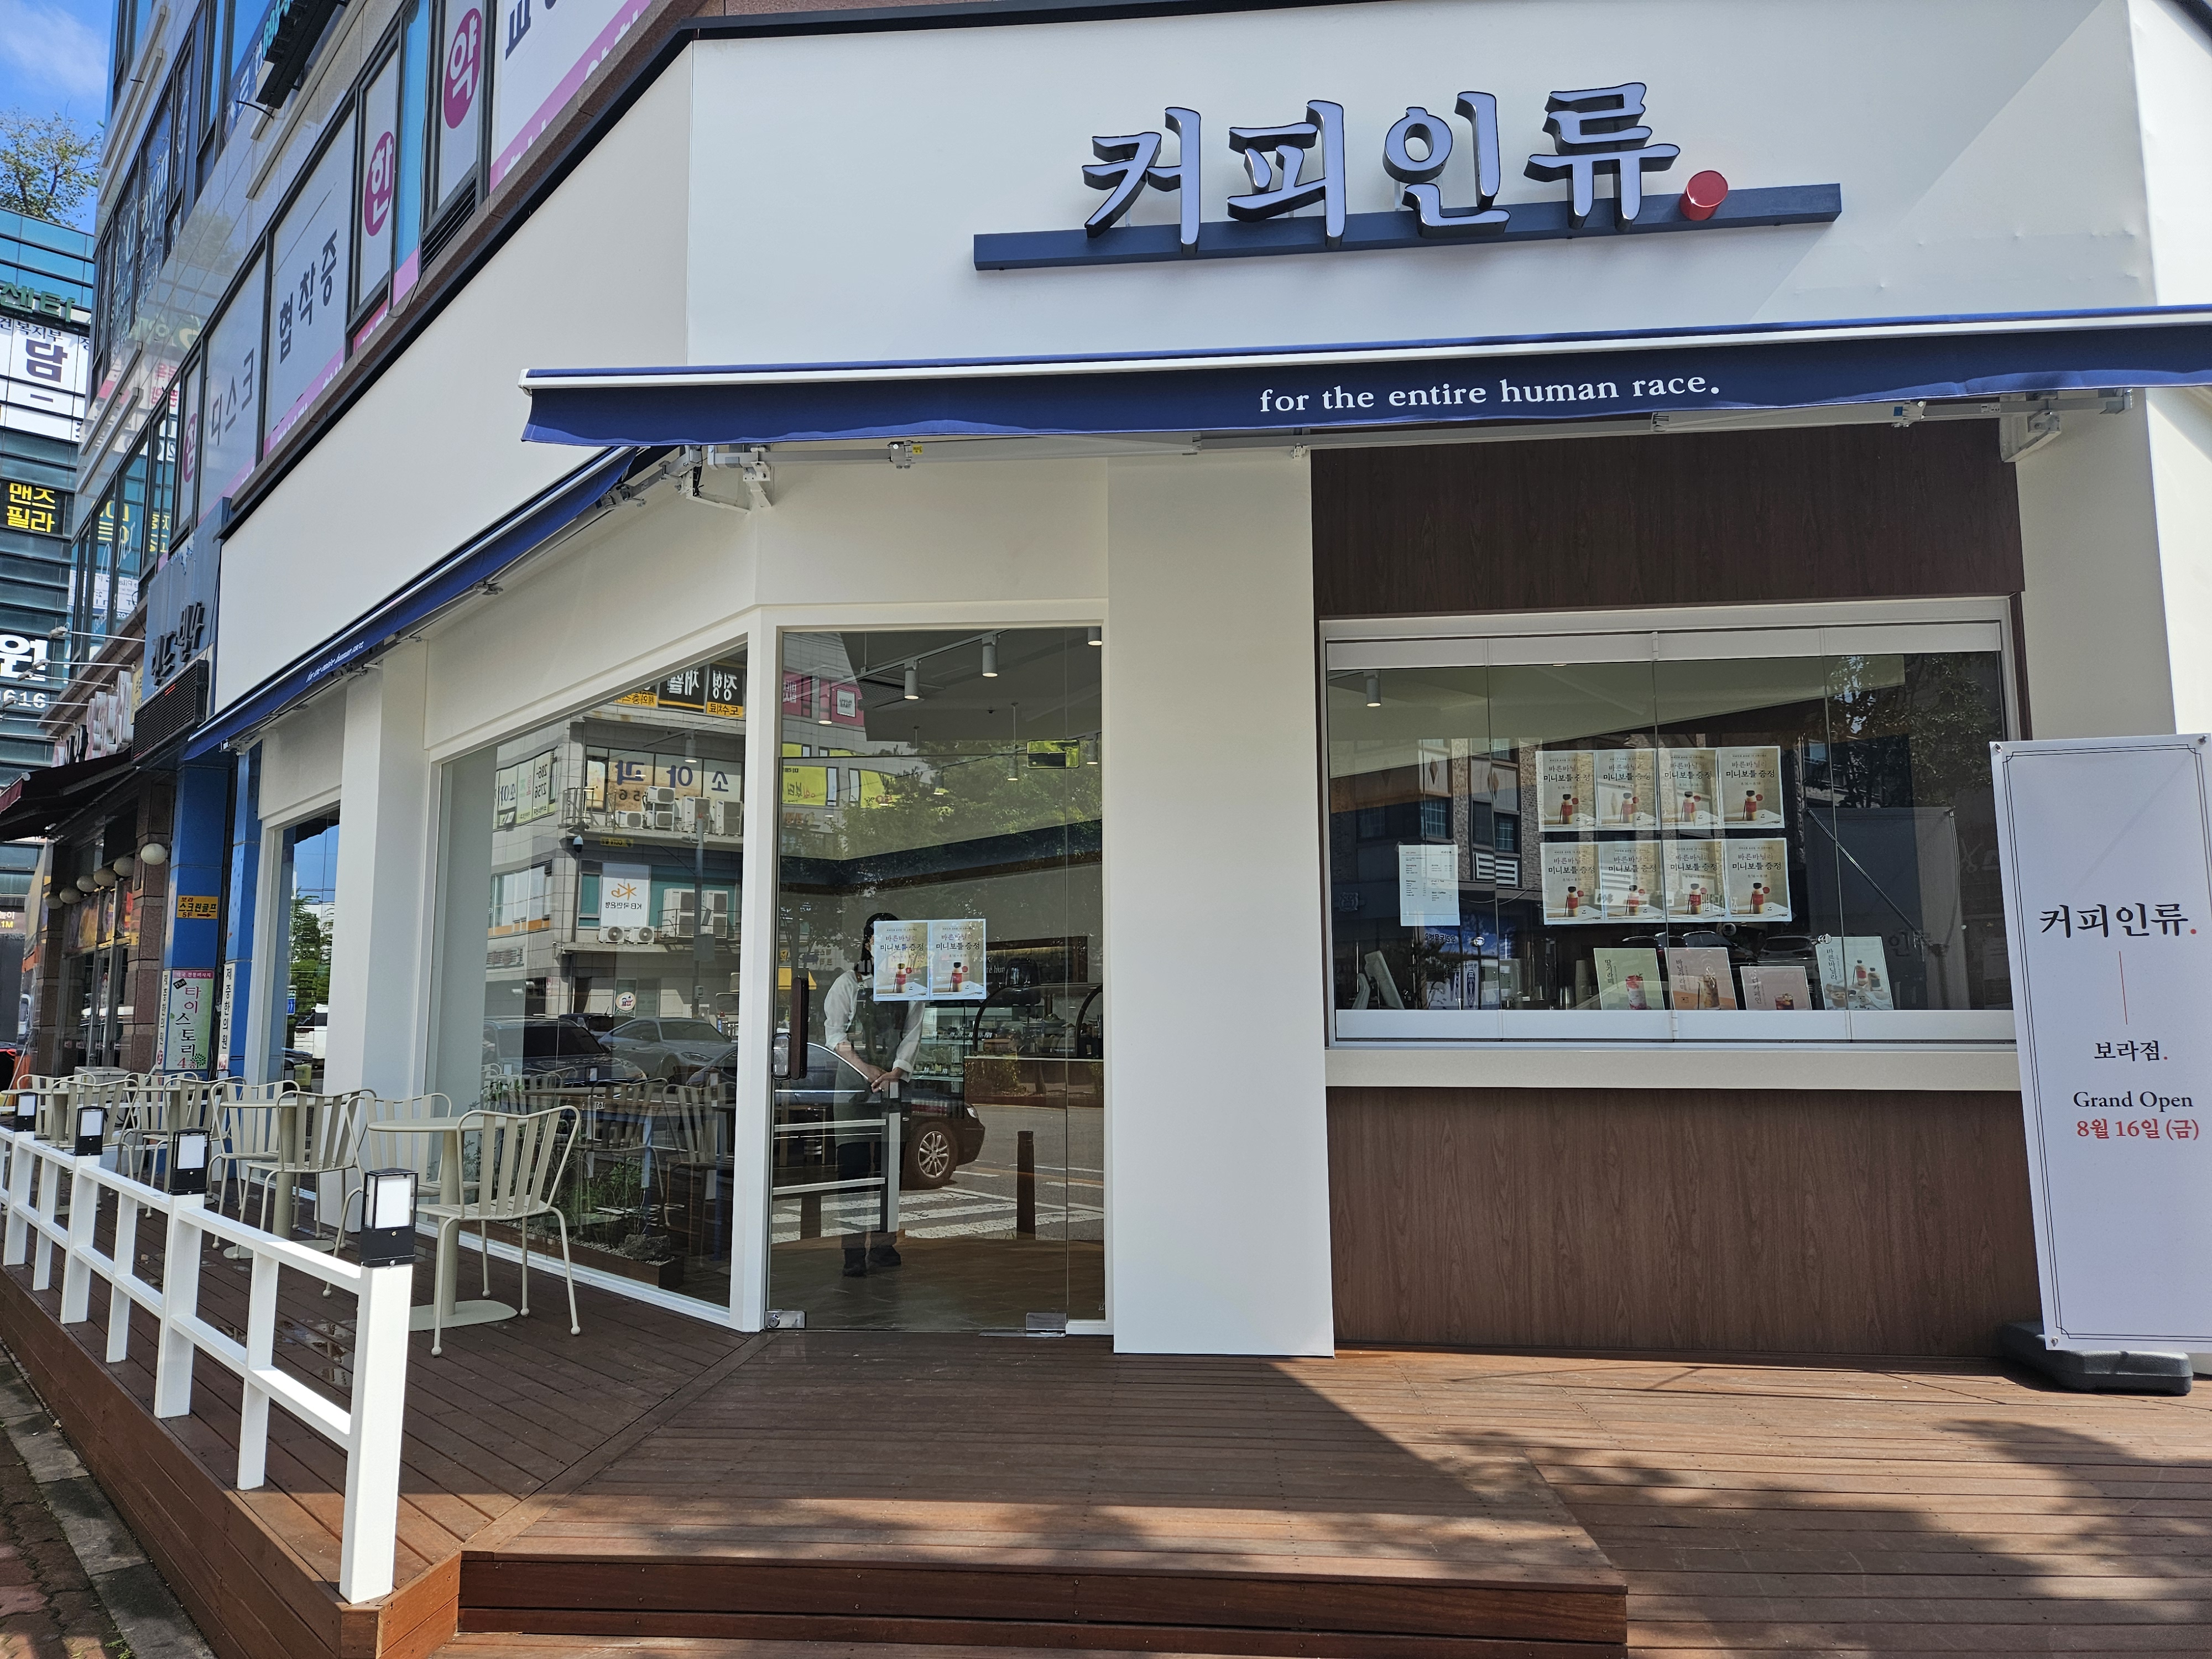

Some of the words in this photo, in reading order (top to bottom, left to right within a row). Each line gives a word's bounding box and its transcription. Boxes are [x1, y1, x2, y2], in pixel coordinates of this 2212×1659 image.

[451, 14, 479, 100] 약
[372, 135, 393, 226] 한
[279, 228, 337, 364] 협착증
[25, 338, 68, 383] 담
[211, 348, 254, 446] 디스크
[1260, 388, 1310, 413] for
[1322, 385, 1375, 409] the
[1389, 382, 1488, 406] entire
[1500, 379, 1620, 404] human
[1632, 374, 1720, 398] race.
[1726, 769, 1757, 778] 미니보틀
[1759, 769, 1775, 778] 증정
[1732, 862, 1763, 870] 미니보틀
[1765, 862, 1782, 870] 증정
[179, 902, 217, 913] 스크린골프
[880, 943, 908, 952] 미니보틀
[909, 943, 924, 951] 증정
[936, 942, 964, 951] 미니보틀
[965, 942, 980, 950] 증정
[175, 986, 202, 1057] 타이스토리
[222, 968, 232, 1049] 제중한의원
[2094, 1040, 2168, 1062] 보라점.
[2073, 1091, 2134, 1108] Grand
[2140, 1091, 2194, 1113] Open
[2077, 1118, 2110, 1139] 8월
[2115, 1118, 2160, 1139] 16일
[2166, 1119, 2199, 1141] (금)
